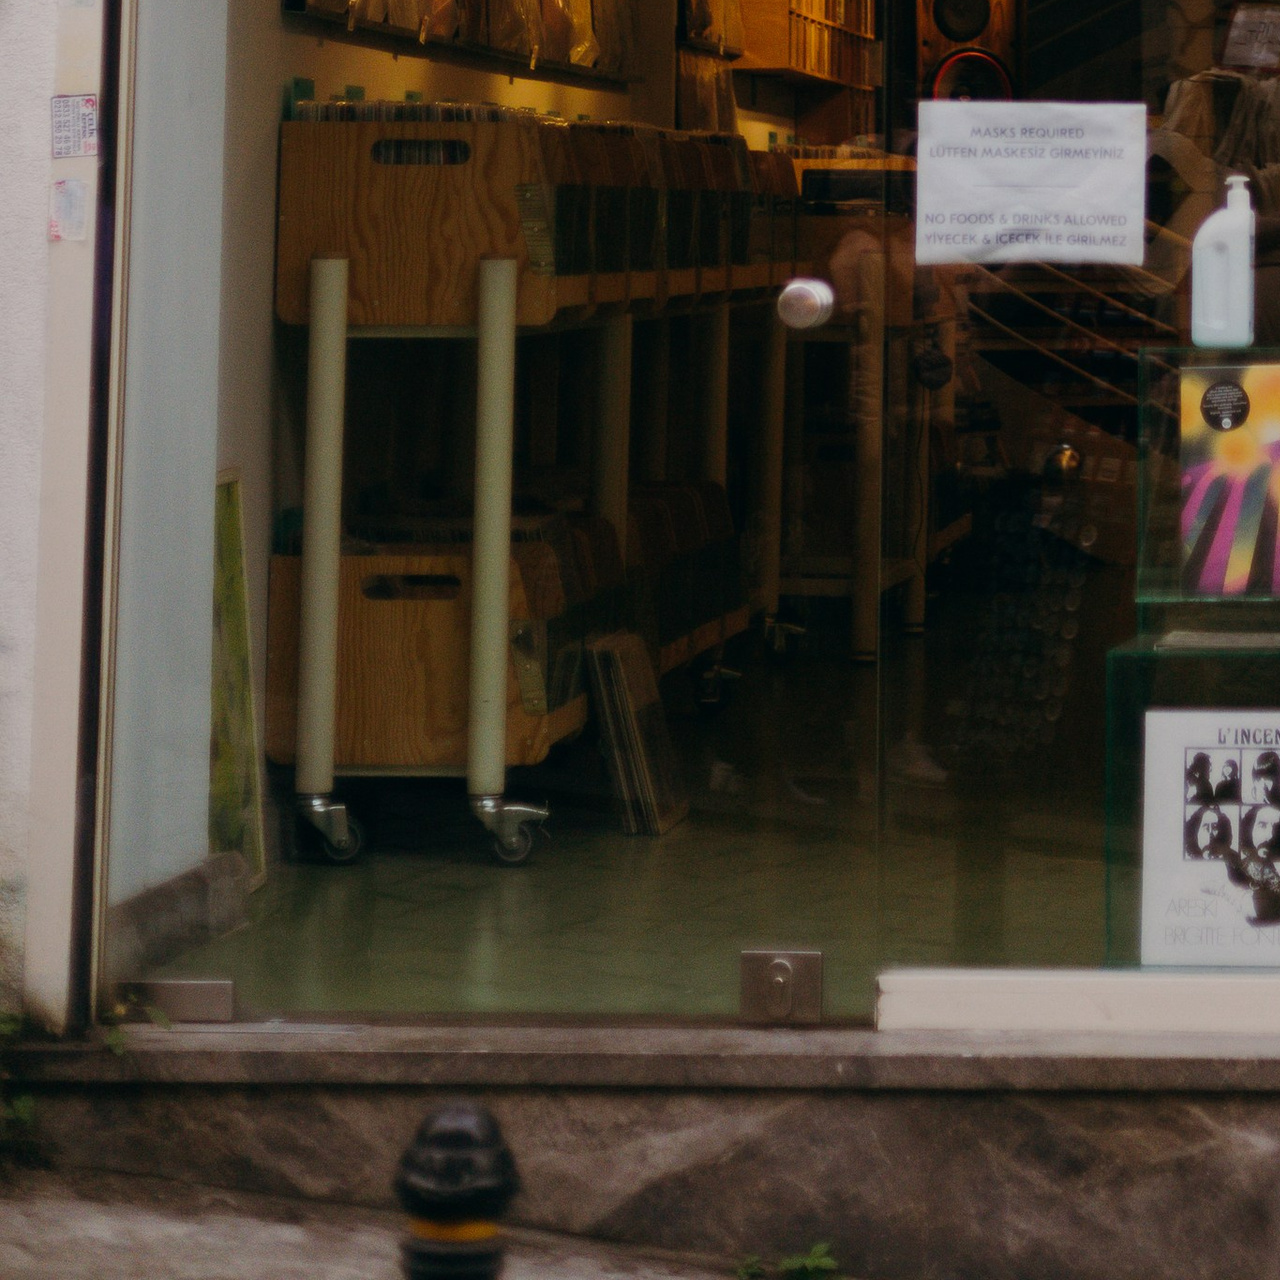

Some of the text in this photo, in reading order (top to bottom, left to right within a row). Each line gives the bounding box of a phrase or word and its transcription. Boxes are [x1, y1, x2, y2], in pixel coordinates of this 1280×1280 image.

[970, 126, 1085, 140] MASKS REQUIRED
[929, 144, 1125, 160] LÜTFEN MASKESİZ GİRMEYİNİZ
[925, 213, 1128, 227] NO FOODS & DRINKS ALLOWED
